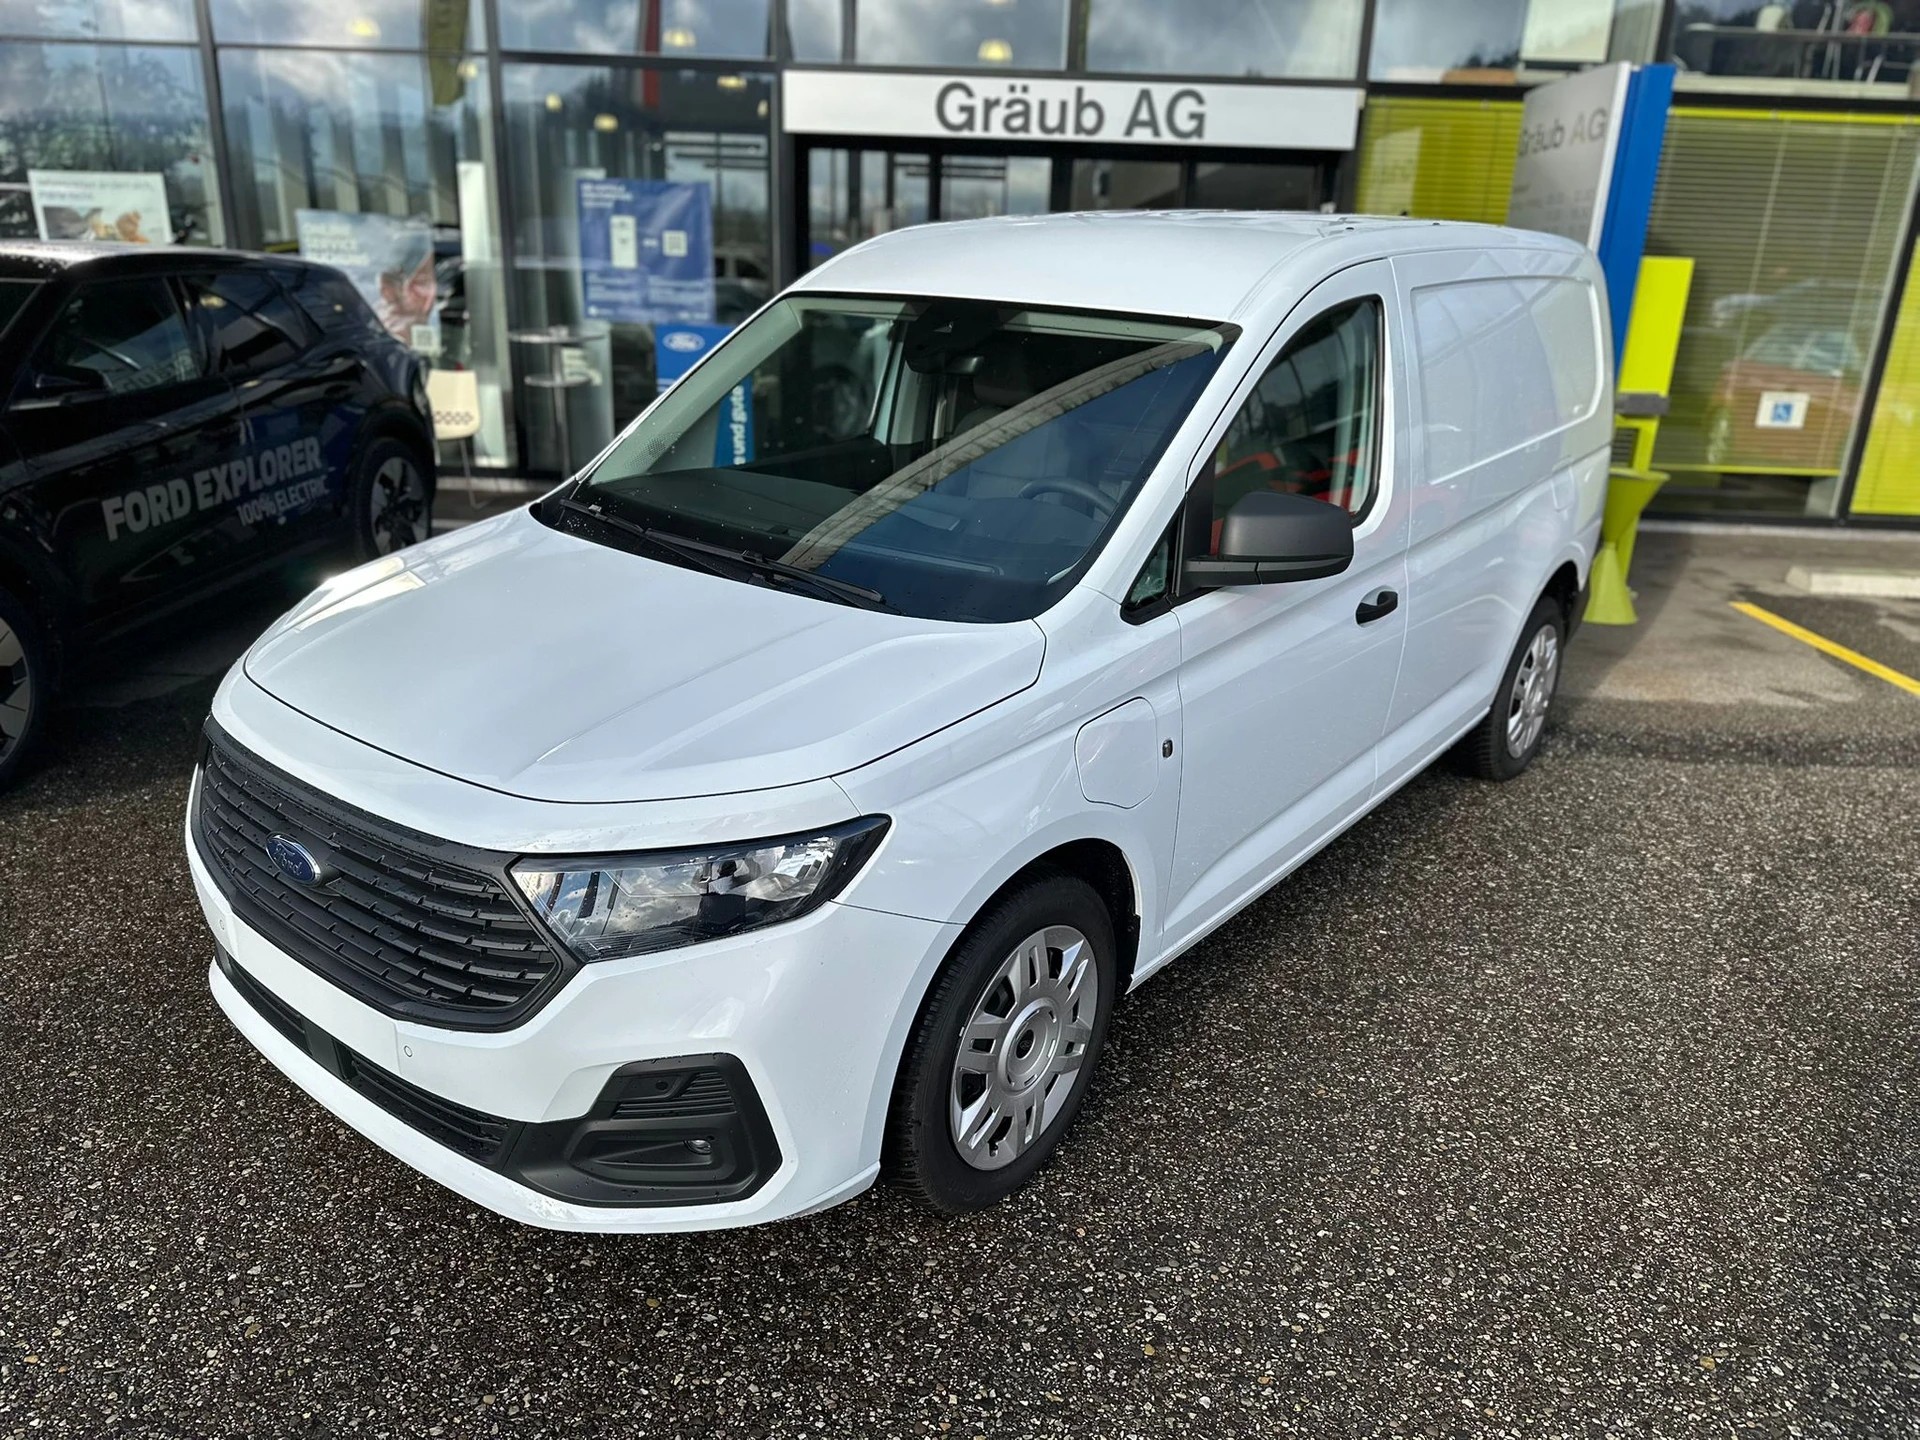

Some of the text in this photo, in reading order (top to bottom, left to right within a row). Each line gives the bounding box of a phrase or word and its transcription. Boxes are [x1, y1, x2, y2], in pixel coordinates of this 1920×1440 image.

[935, 81, 1206, 139] Gräub AG
[1570, 107, 1608, 147] AG
[730, 423, 746, 455] und
[102, 436, 322, 541] FORD EXPLORER
[236, 474, 331, 526] 100% ELECTRIC
[271, 841, 304, 877] Ford
